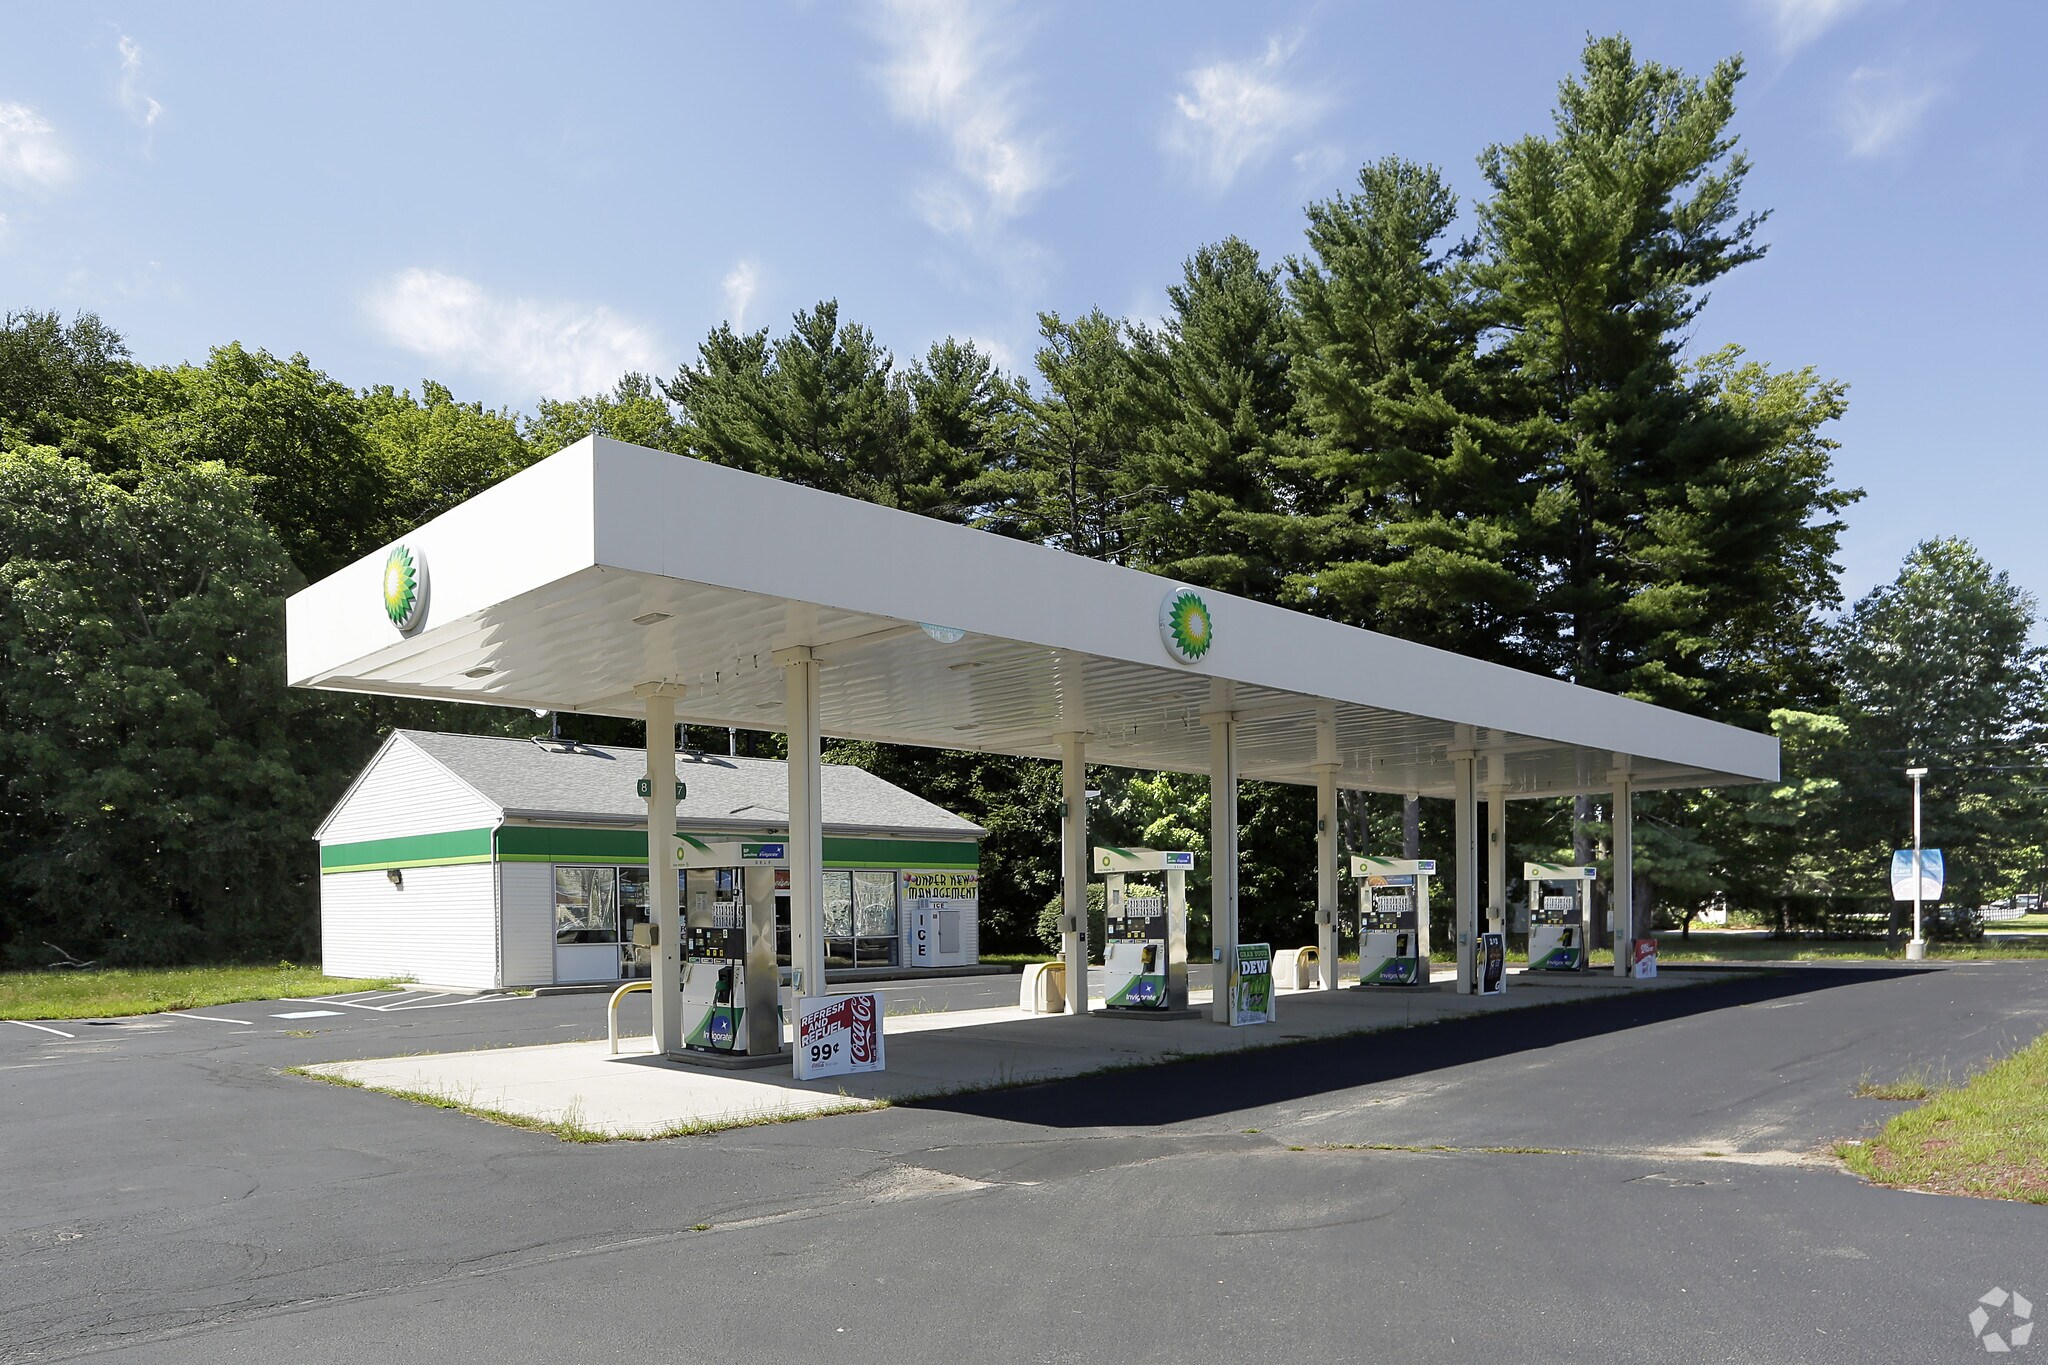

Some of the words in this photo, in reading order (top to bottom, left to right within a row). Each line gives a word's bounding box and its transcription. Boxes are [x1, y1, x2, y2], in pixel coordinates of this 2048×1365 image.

[641, 782, 648, 793] 8
[676, 785, 683, 796] 7
[914, 874, 947, 886] UNDER
[949, 874, 970, 886] NEW
[908, 886, 977, 900] MANAGEMENT
[917, 914, 927, 956] ICE
[1241, 960, 1269, 975] DEW
[1380, 972, 1409, 980] Invigoate
[801, 1002, 845, 1027] REFRESH
[808, 1018, 829, 1034] AND
[703, 1030, 733, 1042] Inigorate
[801, 1020, 845, 1047] REFUEL
[811, 1043, 840, 1062] 99¢
